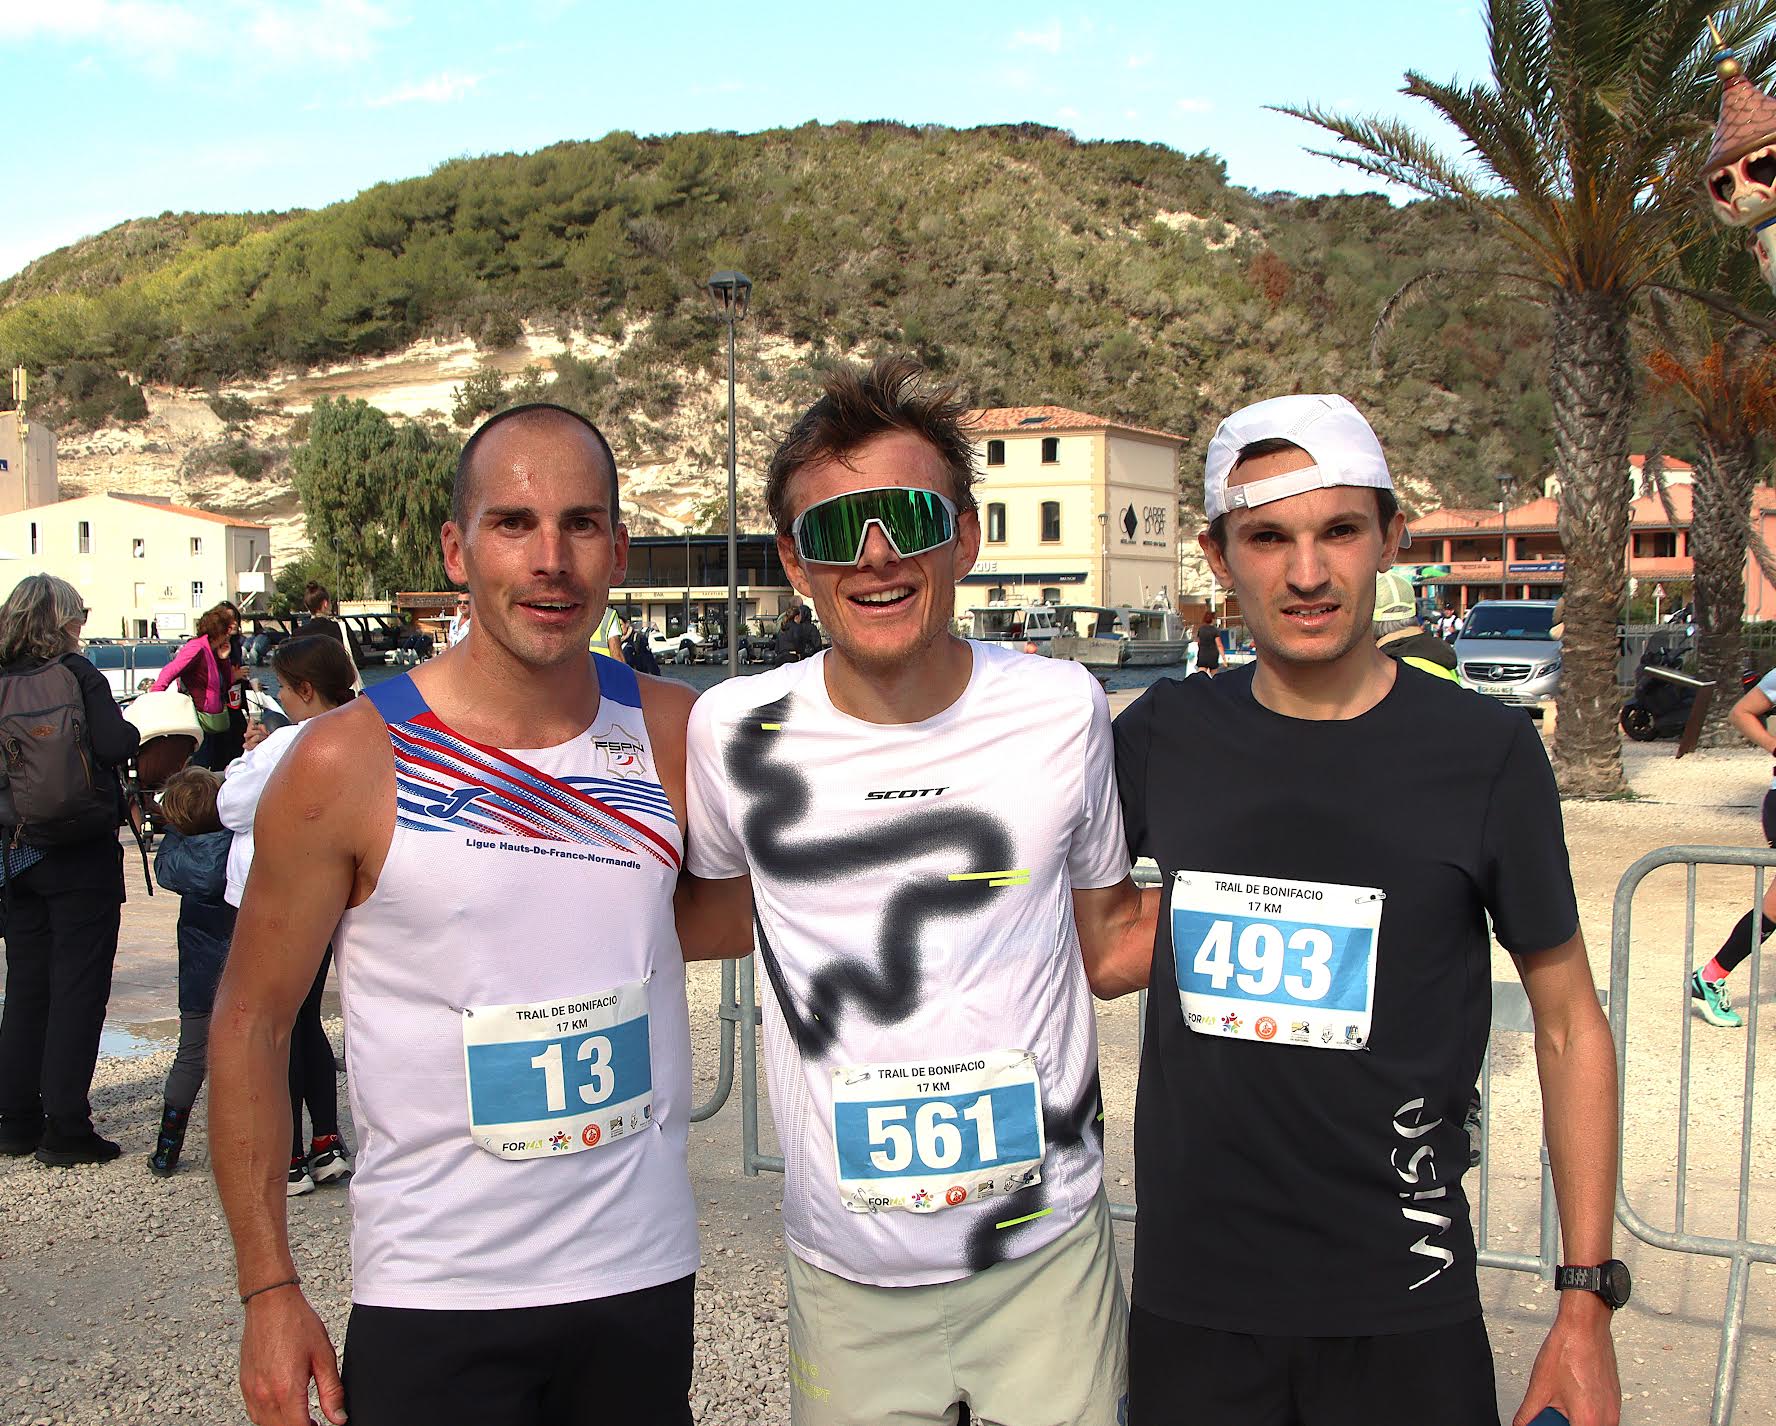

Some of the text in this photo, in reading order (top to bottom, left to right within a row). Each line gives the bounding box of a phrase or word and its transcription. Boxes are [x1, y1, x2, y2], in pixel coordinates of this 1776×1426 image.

[594, 741, 645, 752] FSPN
[864, 786, 950, 801] SCOTT
[466, 838, 641, 870] Ligue Hauts-De-France-Normandie
[1214, 880, 1324, 901] TRAIL DE BONIFACIO
[1248, 901, 1282, 914] 17 KM
[1193, 919, 1333, 1001] 493
[516, 995, 618, 1021] TRAIL DE BONIFACIO
[556, 1018, 588, 1033] 17 KM
[531, 1035, 615, 1112] 13
[878, 1060, 986, 1079] TRAIL DE BONIFACIO
[917, 1081, 950, 1093] 17 KM
[866, 1094, 998, 1172] 561
